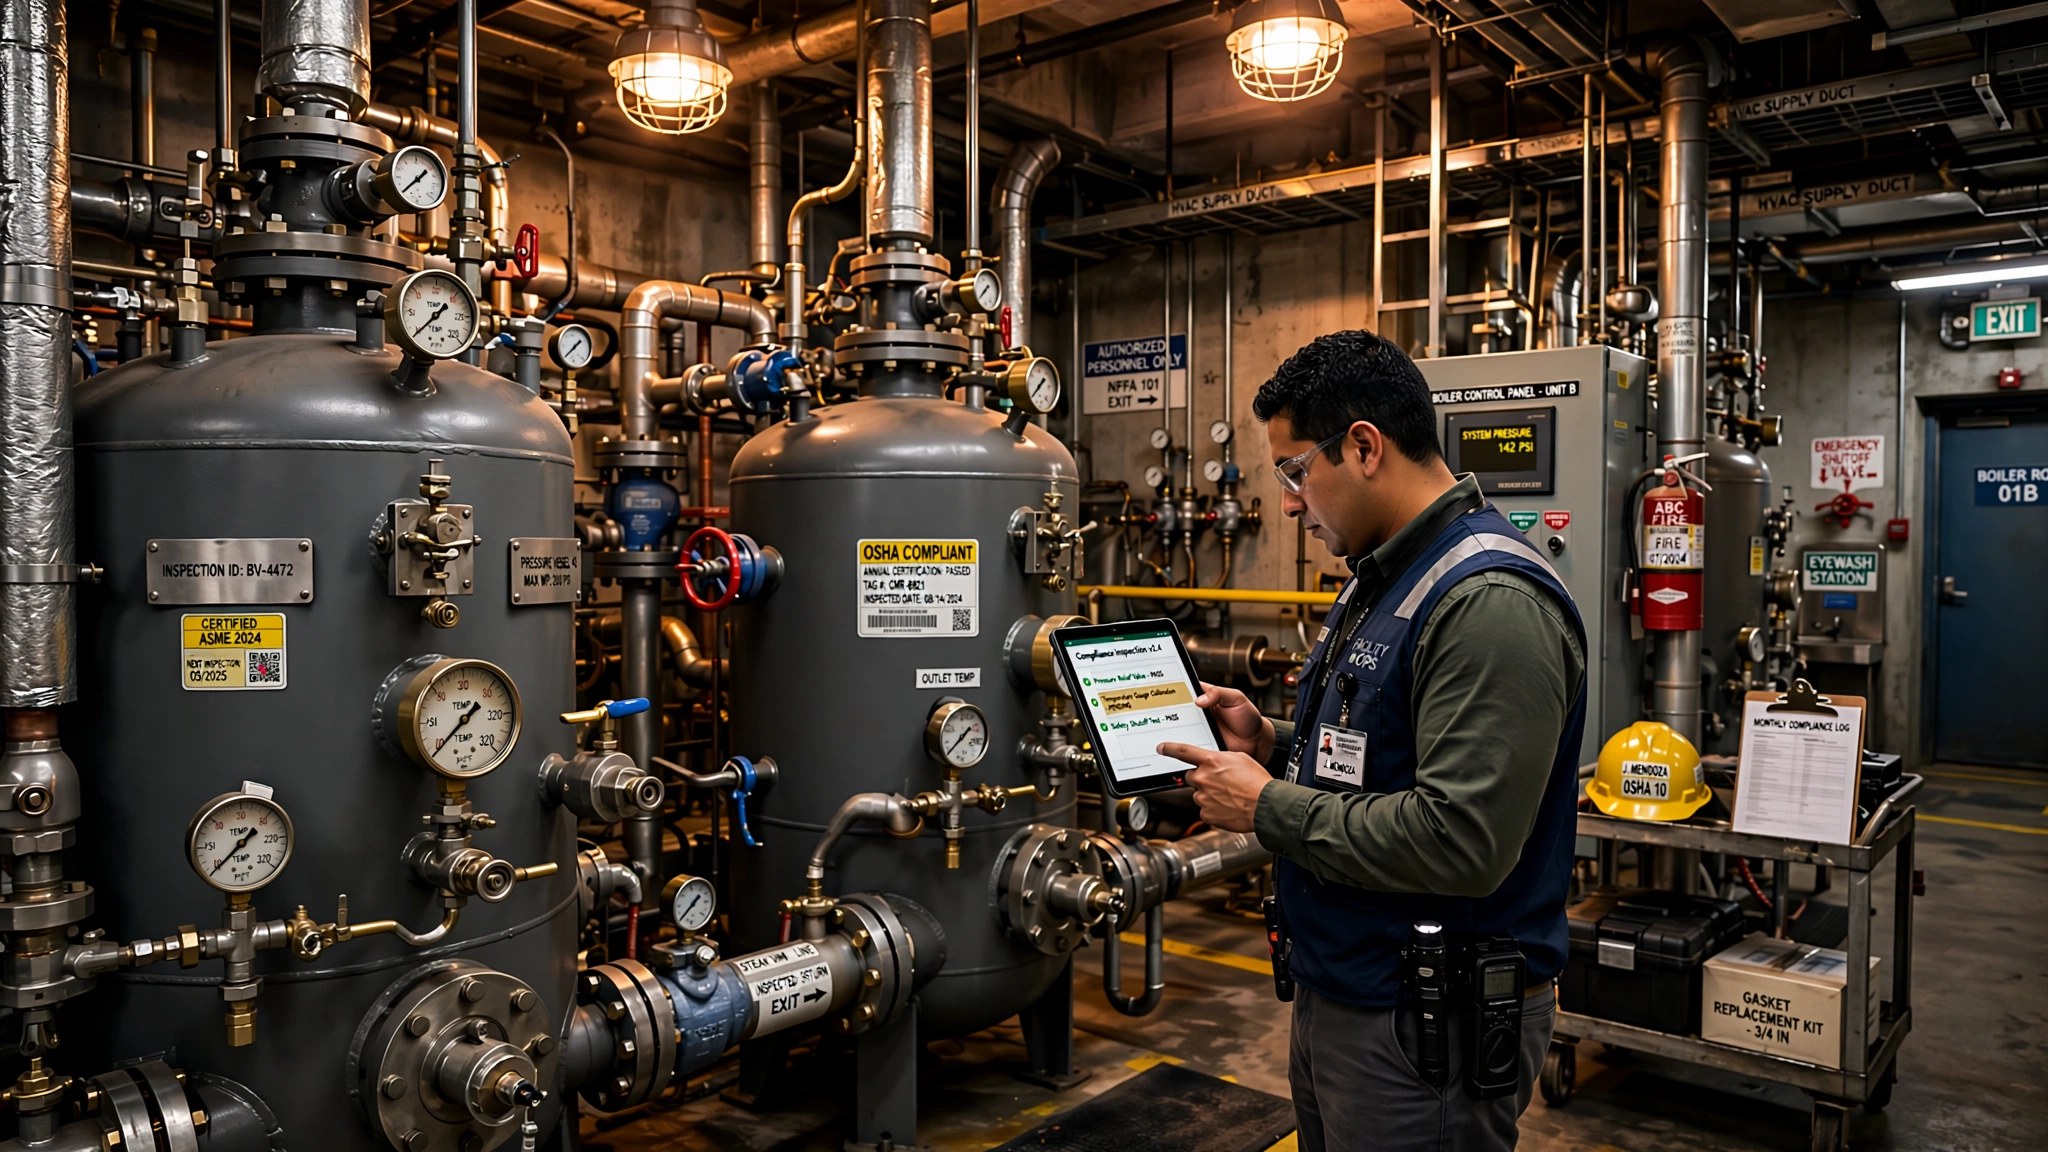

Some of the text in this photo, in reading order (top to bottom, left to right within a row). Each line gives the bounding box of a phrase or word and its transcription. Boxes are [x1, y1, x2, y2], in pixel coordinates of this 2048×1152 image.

[1764, 92, 1814, 112] SUPPLY
[1820, 85, 1856, 102] DUCT
[1804, 184, 1861, 204] SUPPLY
[1868, 176, 1910, 195] DUCT
[1202, 192, 1240, 209] SUPPLY
[1986, 304, 2027, 334] EXIT
[1088, 353, 1182, 374] PERSONNEL ONLY
[1142, 378, 1159, 390] 101
[1432, 392, 1462, 404] BOILER
[1464, 388, 1506, 401] CONTROL
[1508, 386, 1536, 398] PANEL
[1545, 384, 1566, 396] UNIT
[1569, 383, 1576, 394] B
[1108, 396, 1132, 408] EXIT
[1462, 428, 1492, 440] SYSTEM
[1498, 442, 1534, 453] 142 PSI
[1814, 439, 1880, 452] EMERGENCY
[1822, 452, 1870, 466] SHUTOFF
[1978, 468, 2027, 482] BOILER
[1998, 484, 2038, 502] 01B
[1654, 502, 1684, 514] ABC
[1652, 514, 1689, 526] FIRE
[1656, 538, 1682, 549] FIRE
[864, 544, 973, 561] OSHA COMPLIANT
[1809, 556, 1872, 570] EYEWASH
[162, 564, 294, 578] INSPECTION ID: BV-4472
[1811, 571, 1866, 584] STATION
[863, 580, 878, 590] TAG
[201, 618, 258, 630] CERTIFIED
[199, 632, 262, 646] ASME 2024
[922, 672, 976, 684] OUTLET TEMP
[452, 700, 472, 710] TEMP
[488, 710, 502, 720] 320
[1754, 718, 1850, 732] MONTHLY COMPLIANCE LOG
[455, 734, 473, 742] TEMP
[479, 734, 494, 746] 320
[1631, 764, 1668, 777] MENDOZA
[1624, 780, 1667, 797] OSHA 10
[230, 827, 248, 836] TEMP
[772, 993, 800, 1015] EXIT
[1742, 992, 1790, 1012] GASKET
[1714, 1001, 1824, 1035] REPLACEMENT KIT
[1754, 1026, 1773, 1040] 3/4
[1777, 1032, 1790, 1044] IN
